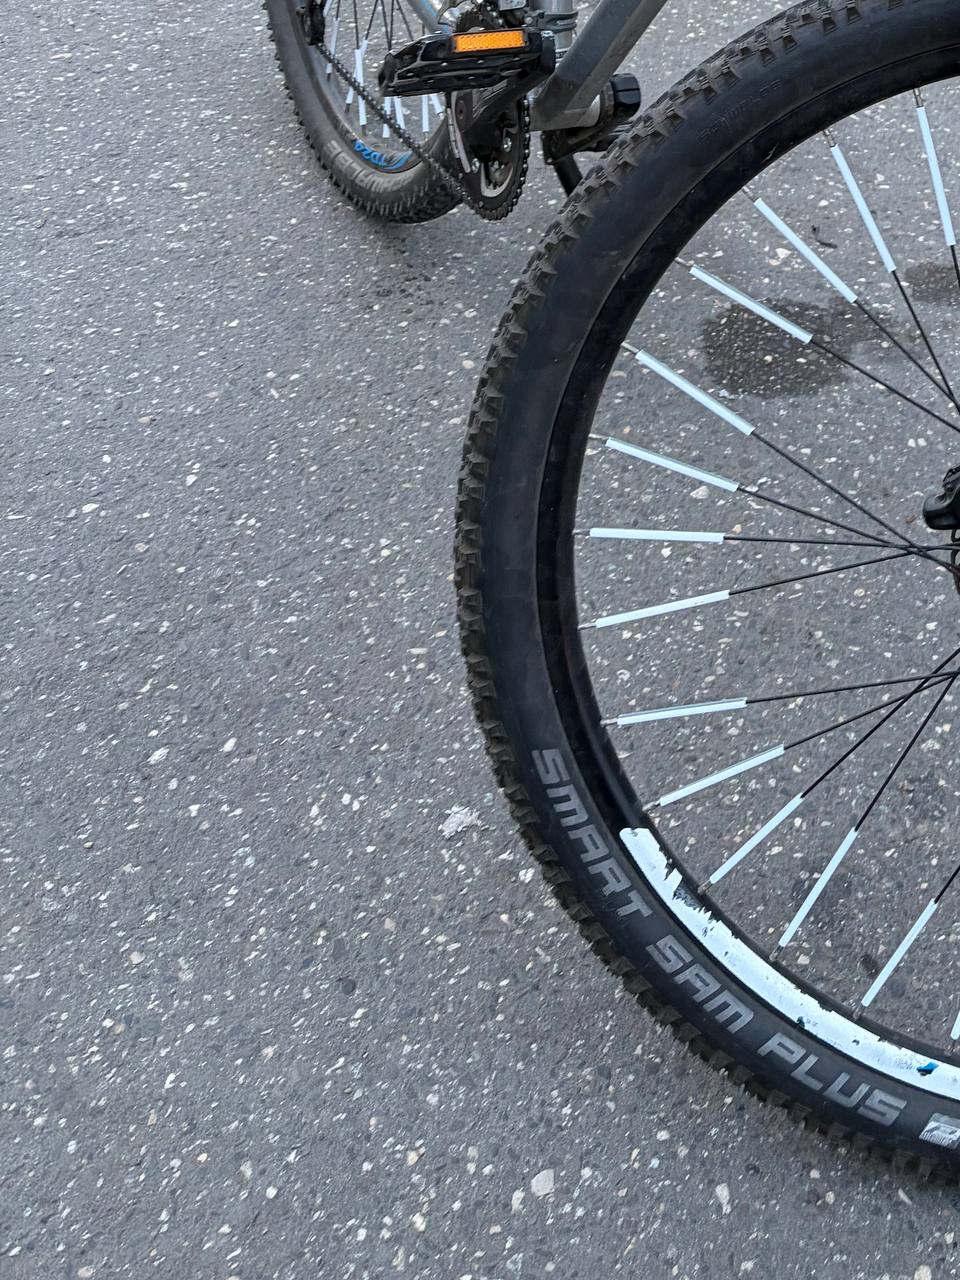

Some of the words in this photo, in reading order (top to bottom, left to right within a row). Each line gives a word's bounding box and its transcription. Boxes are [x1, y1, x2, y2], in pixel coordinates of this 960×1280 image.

[531, 746, 653, 921] SMART
[645, 933, 754, 1034] SAM
[757, 1033, 907, 1127] PLUS
